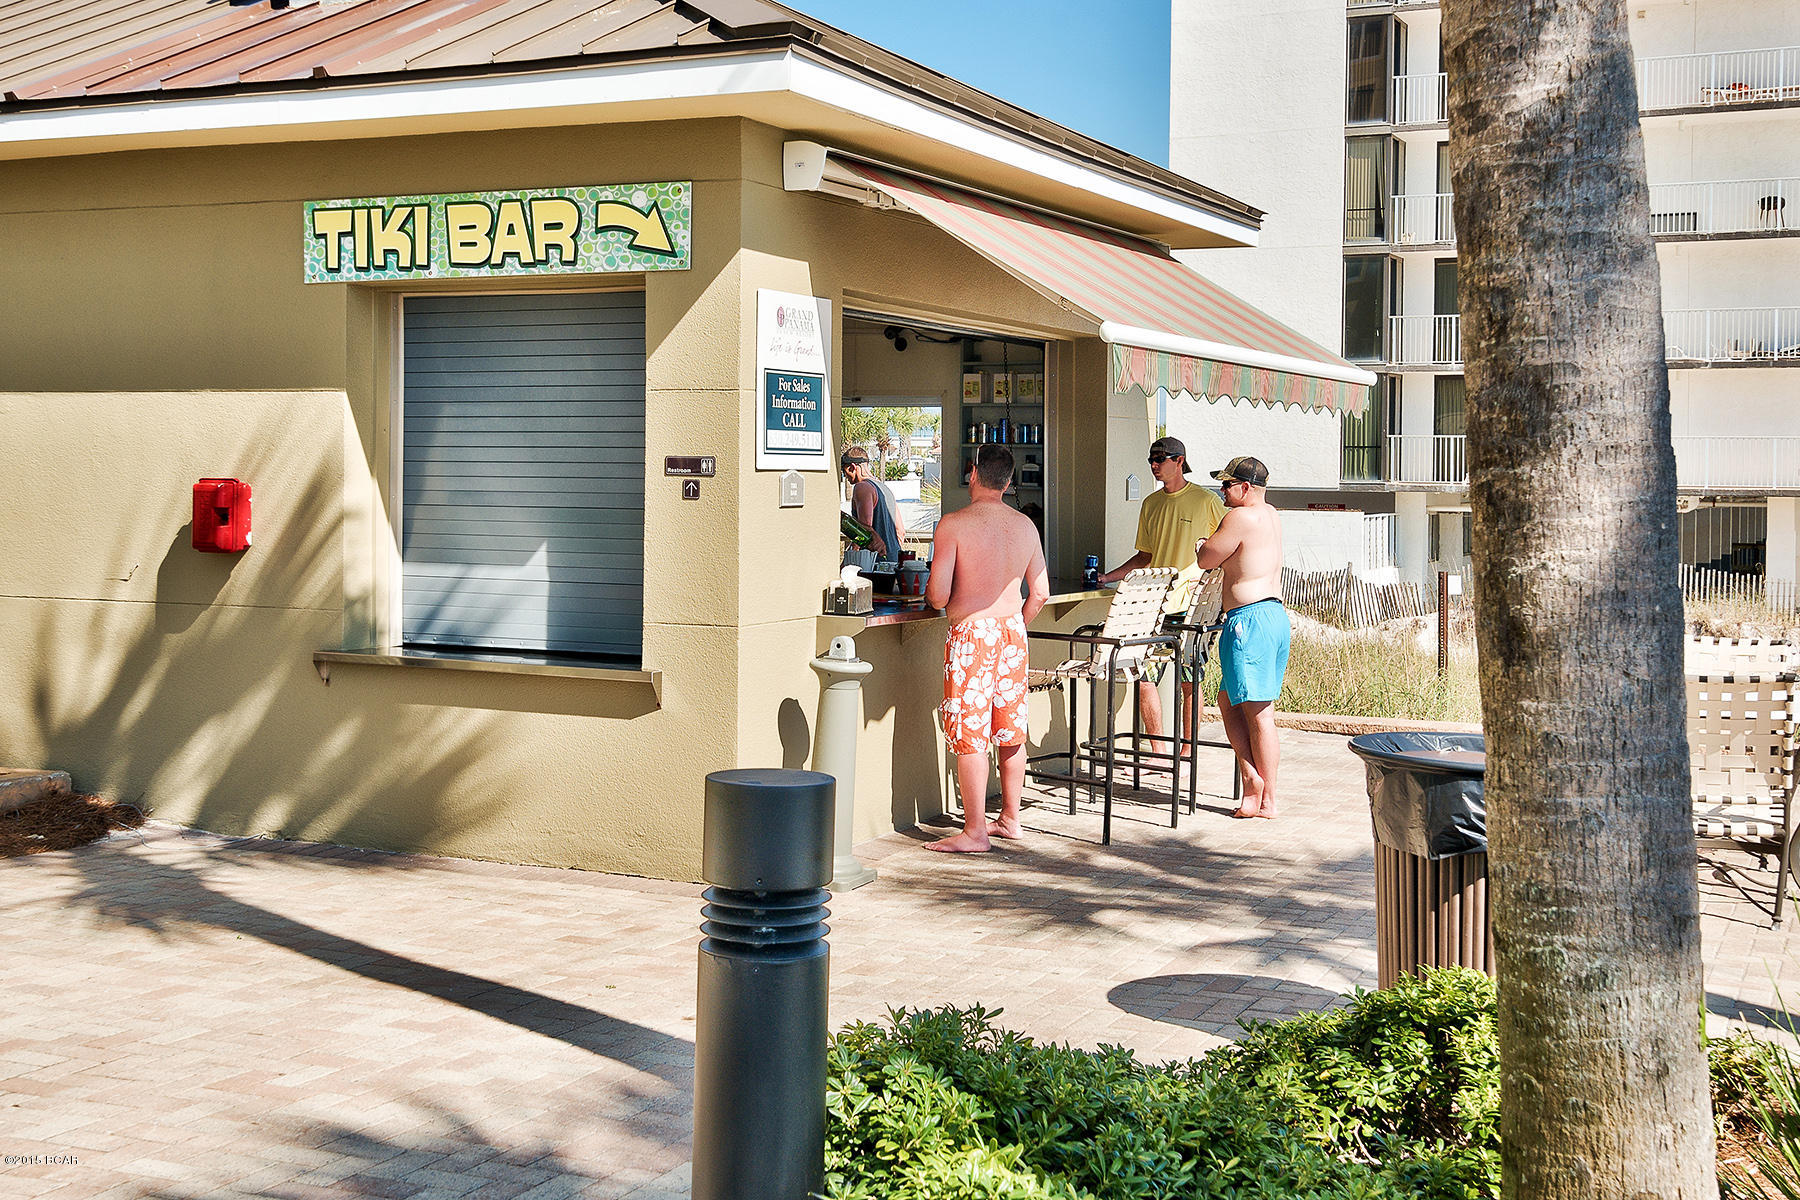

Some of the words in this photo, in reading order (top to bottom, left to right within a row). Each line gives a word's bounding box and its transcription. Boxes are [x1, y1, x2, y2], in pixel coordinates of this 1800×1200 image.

[312, 202, 432, 273] TIKI
[444, 197, 582, 269] BAR
[785, 306, 814, 321] GRAND
[784, 318, 815, 332] PANAMA
[778, 377, 792, 391] For
[792, 378, 811, 393] Sales
[771, 394, 816, 411] Information
[782, 412, 806, 428] CALL
